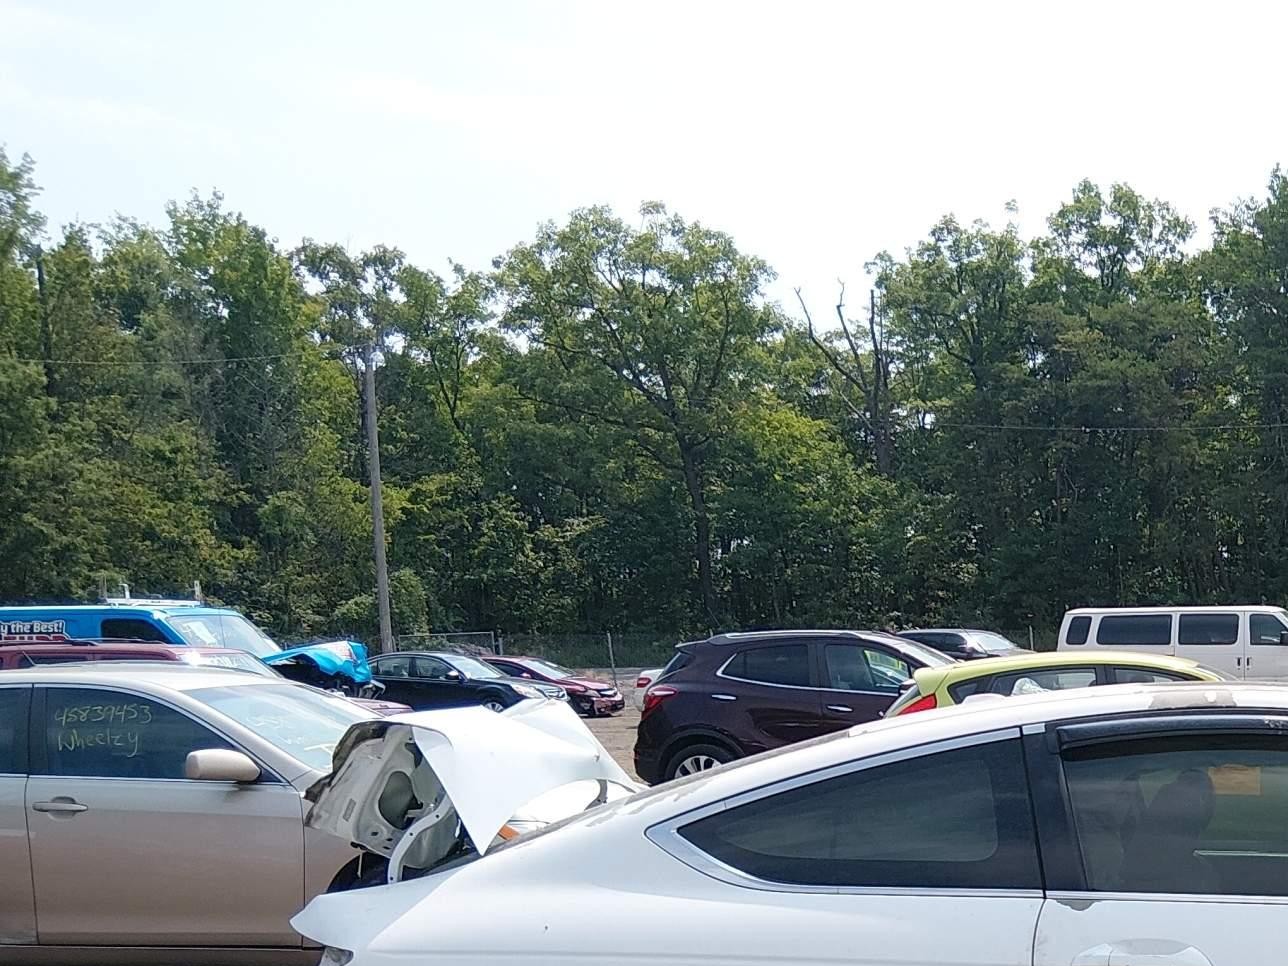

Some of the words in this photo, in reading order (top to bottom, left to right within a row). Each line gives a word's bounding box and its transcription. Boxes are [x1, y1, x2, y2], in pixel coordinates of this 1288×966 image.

[11, 622, 31, 633] the
[33, 622, 63, 633] Best!
[54, 703, 152, 727] 45839453
